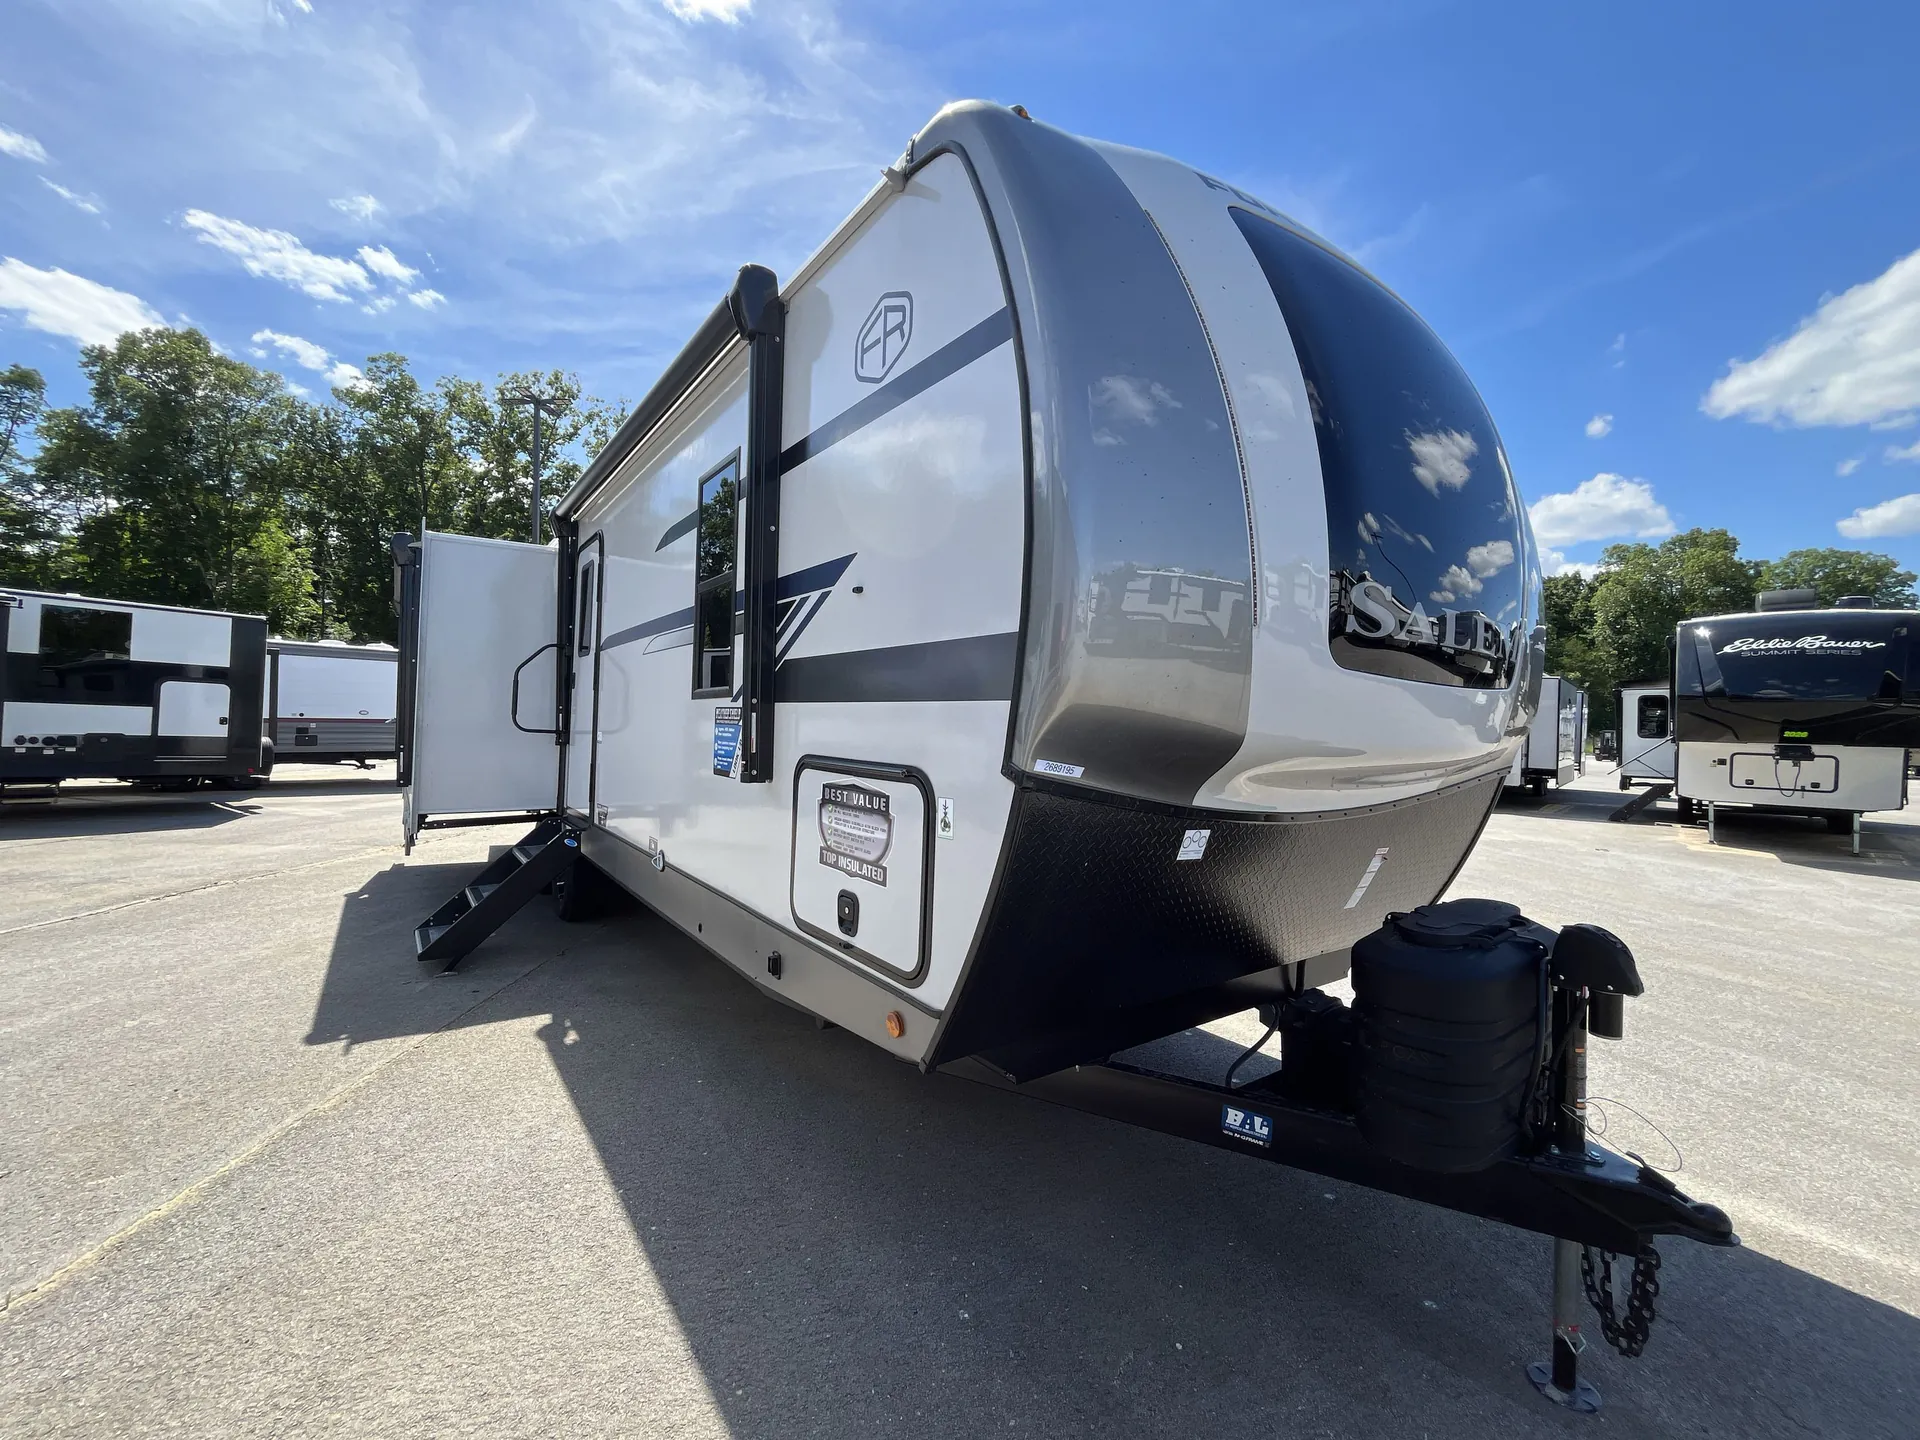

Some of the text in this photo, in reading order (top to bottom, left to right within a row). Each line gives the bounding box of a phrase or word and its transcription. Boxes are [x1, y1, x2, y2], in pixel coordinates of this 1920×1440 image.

[1717, 635, 1886, 655] Eddie Bauer
[1741, 648, 1862, 657] SUMMIT SERIES
[1043, 762, 1076, 775] 2689195
[824, 787, 887, 812] BEST VALUE
[822, 850, 884, 882] TOP INSULATED
